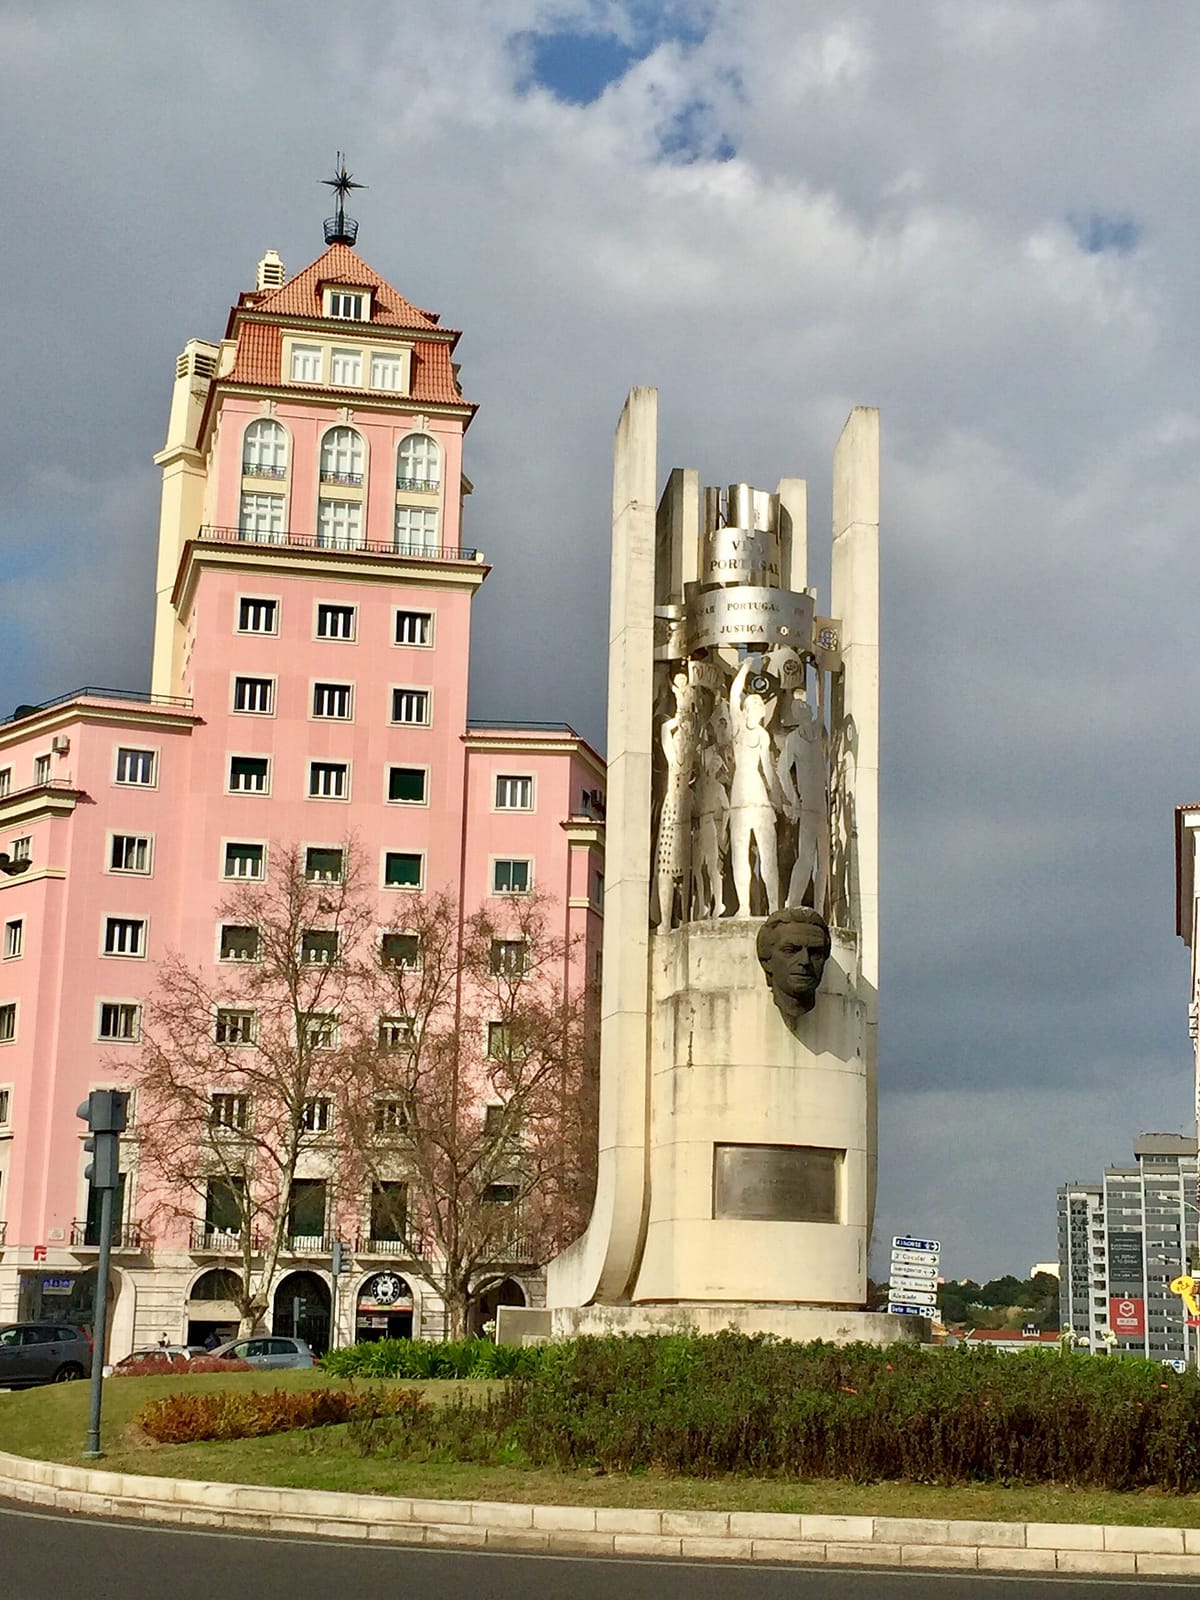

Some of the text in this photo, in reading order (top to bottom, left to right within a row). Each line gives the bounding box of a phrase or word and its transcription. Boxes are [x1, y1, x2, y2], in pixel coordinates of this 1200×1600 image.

[710, 559, 779, 576] PORTGAL
[727, 602, 780, 612] PORTUGAL
[720, 624, 764, 634] JUSTIÇA
